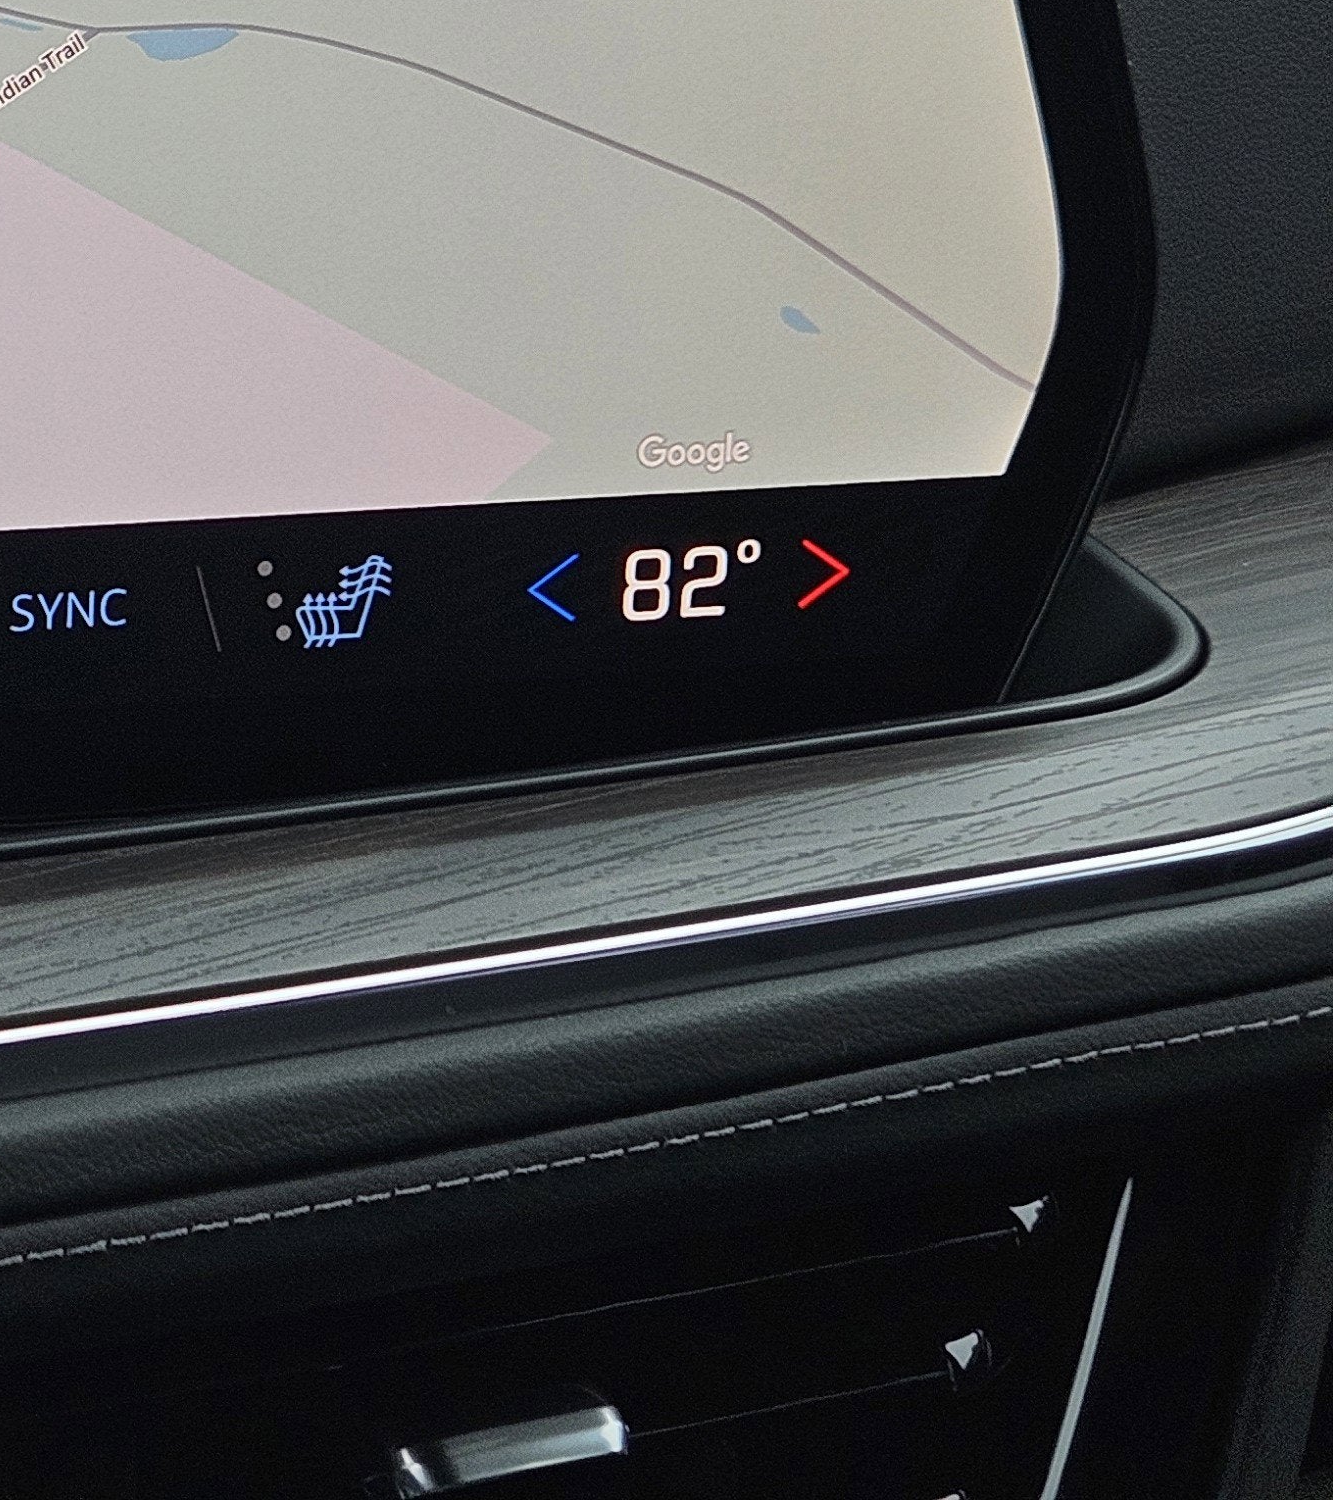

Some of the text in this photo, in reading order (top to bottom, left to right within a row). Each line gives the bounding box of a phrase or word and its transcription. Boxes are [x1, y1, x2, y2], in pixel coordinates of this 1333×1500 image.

[40, 33, 85, 70] Trail
[637, 430, 752, 473] Google
[621, 538, 762, 622] 82°
[9, 587, 128, 633] SYNC
